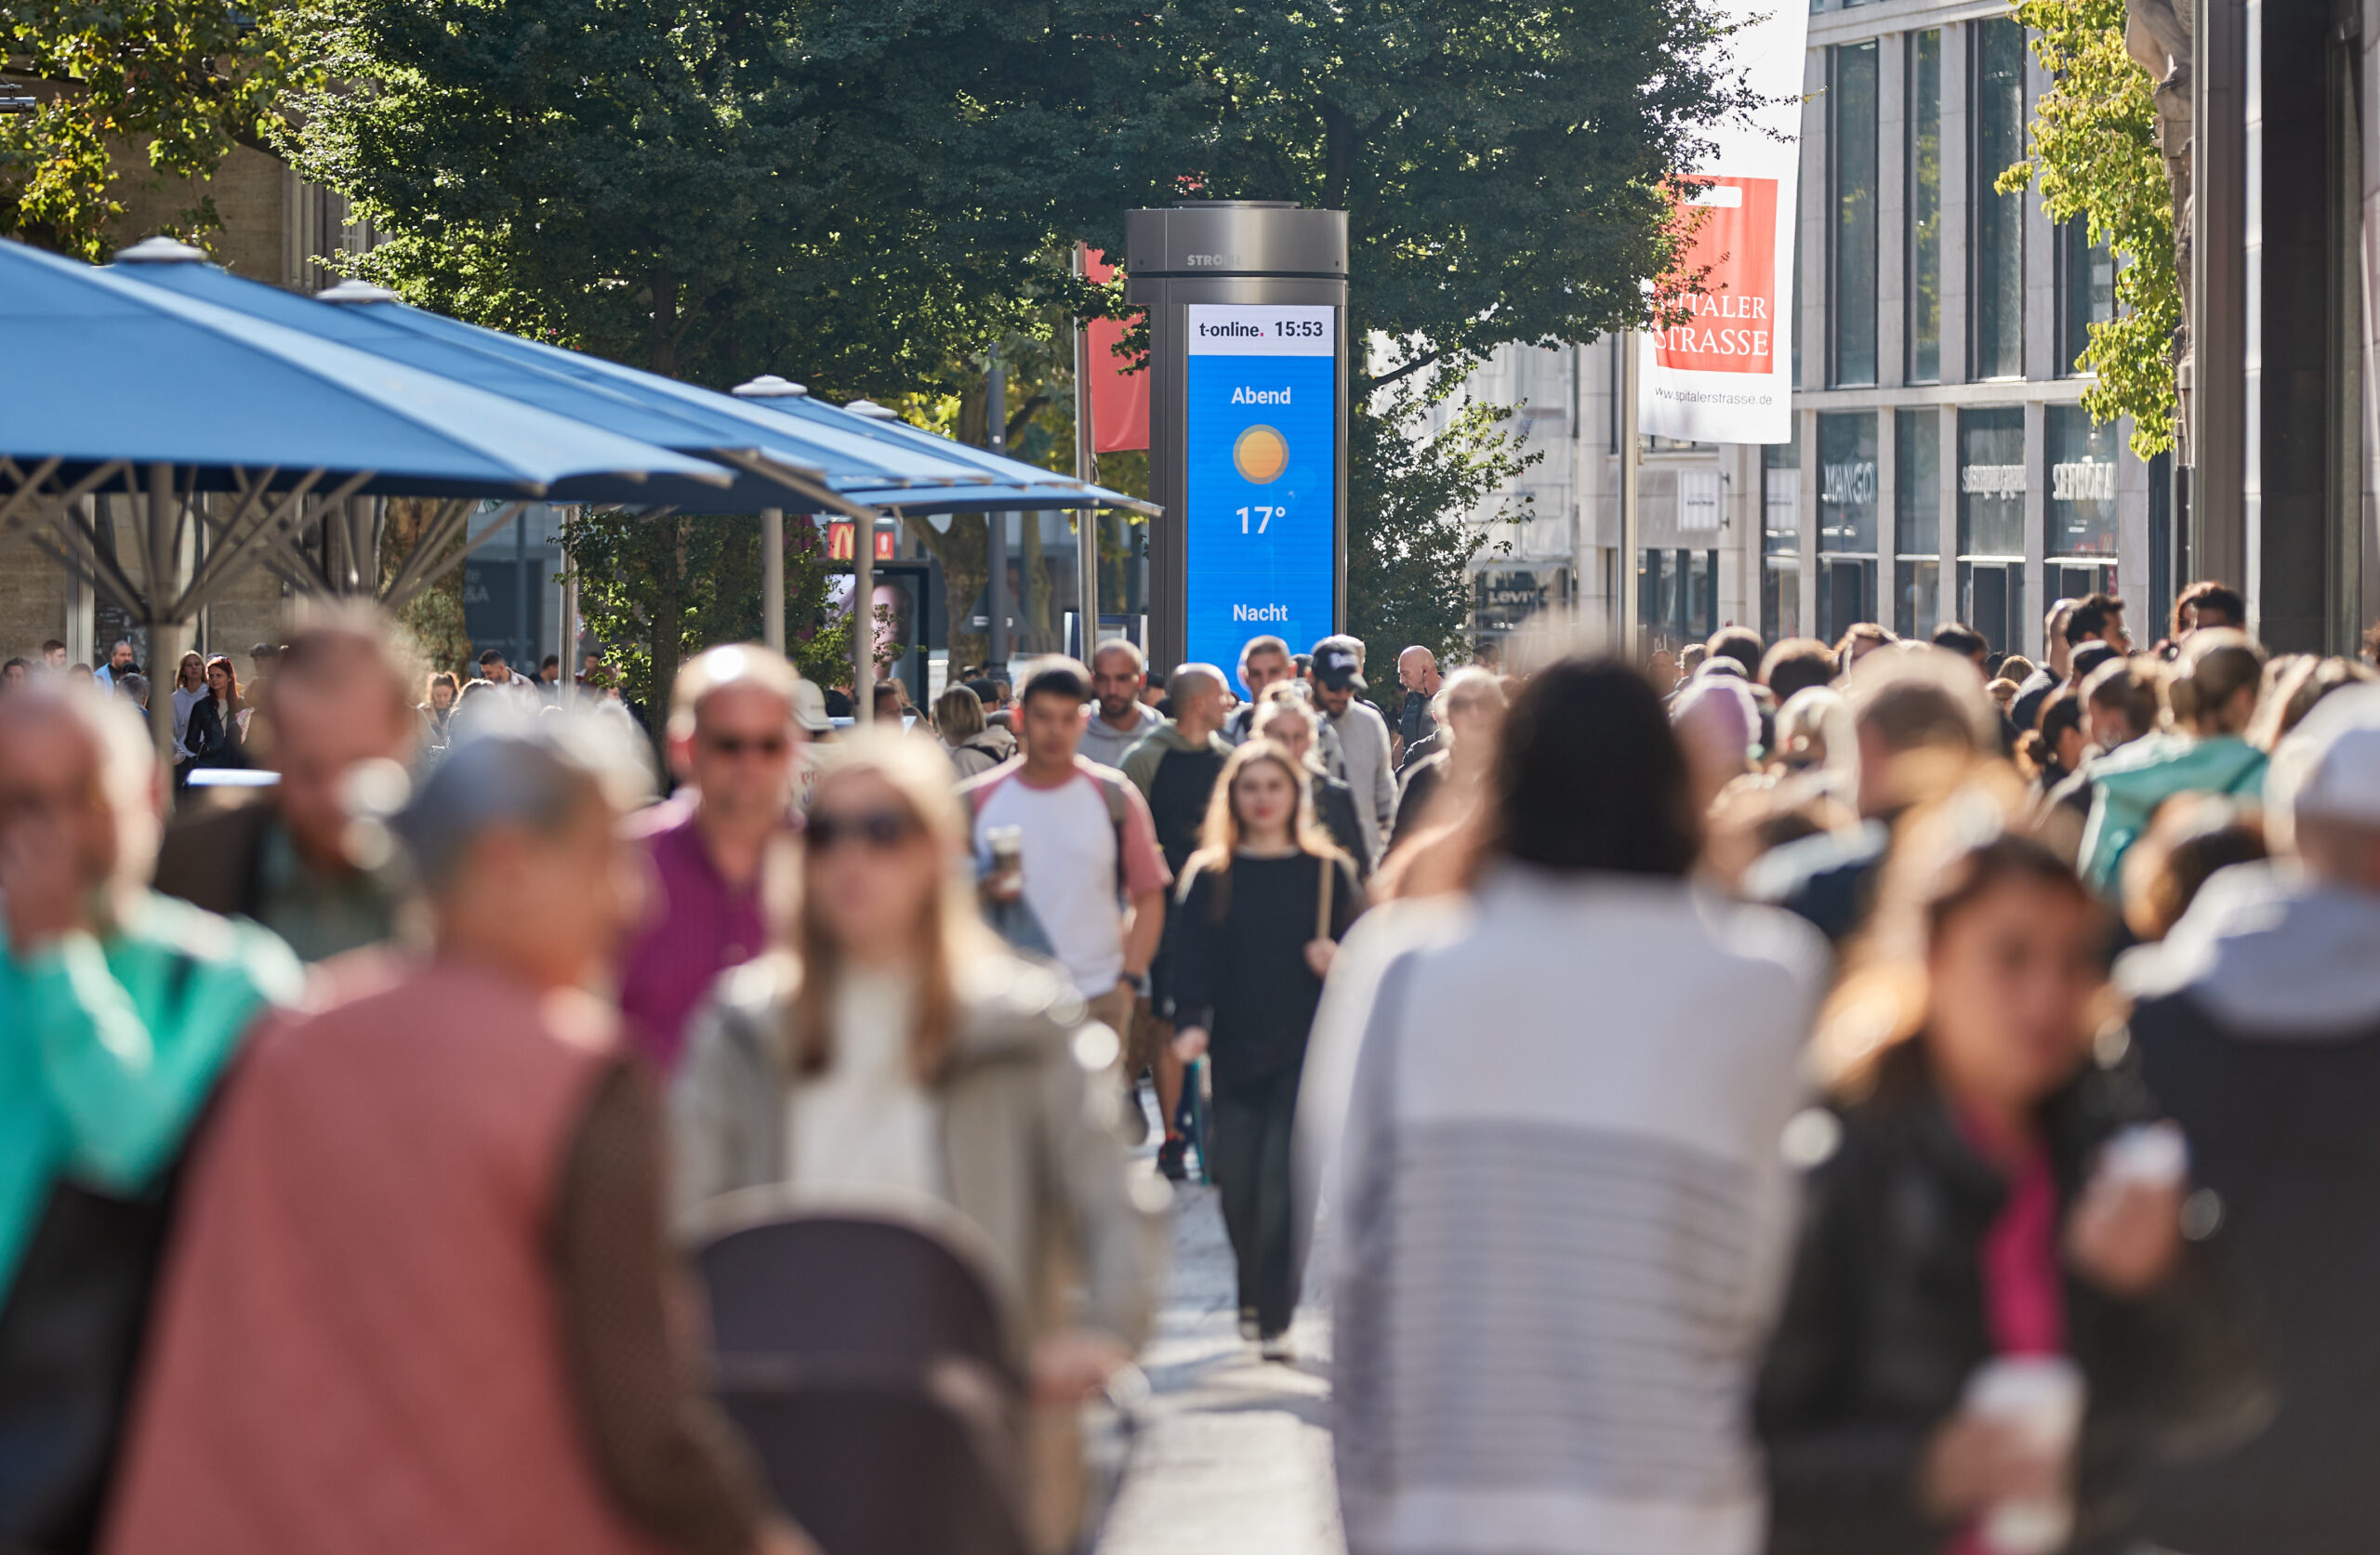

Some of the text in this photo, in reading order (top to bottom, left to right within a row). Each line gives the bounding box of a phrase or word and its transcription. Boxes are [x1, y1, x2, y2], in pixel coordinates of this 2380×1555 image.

[1657, 293, 1767, 319] PITALER
[1199, 322, 1324, 337] t-online. 15:53
[1655, 324, 1769, 356] STRASSE
[1231, 387, 1291, 404] Abend
[1236, 506, 1286, 534] 17°
[1233, 603, 1289, 622] Nacht
